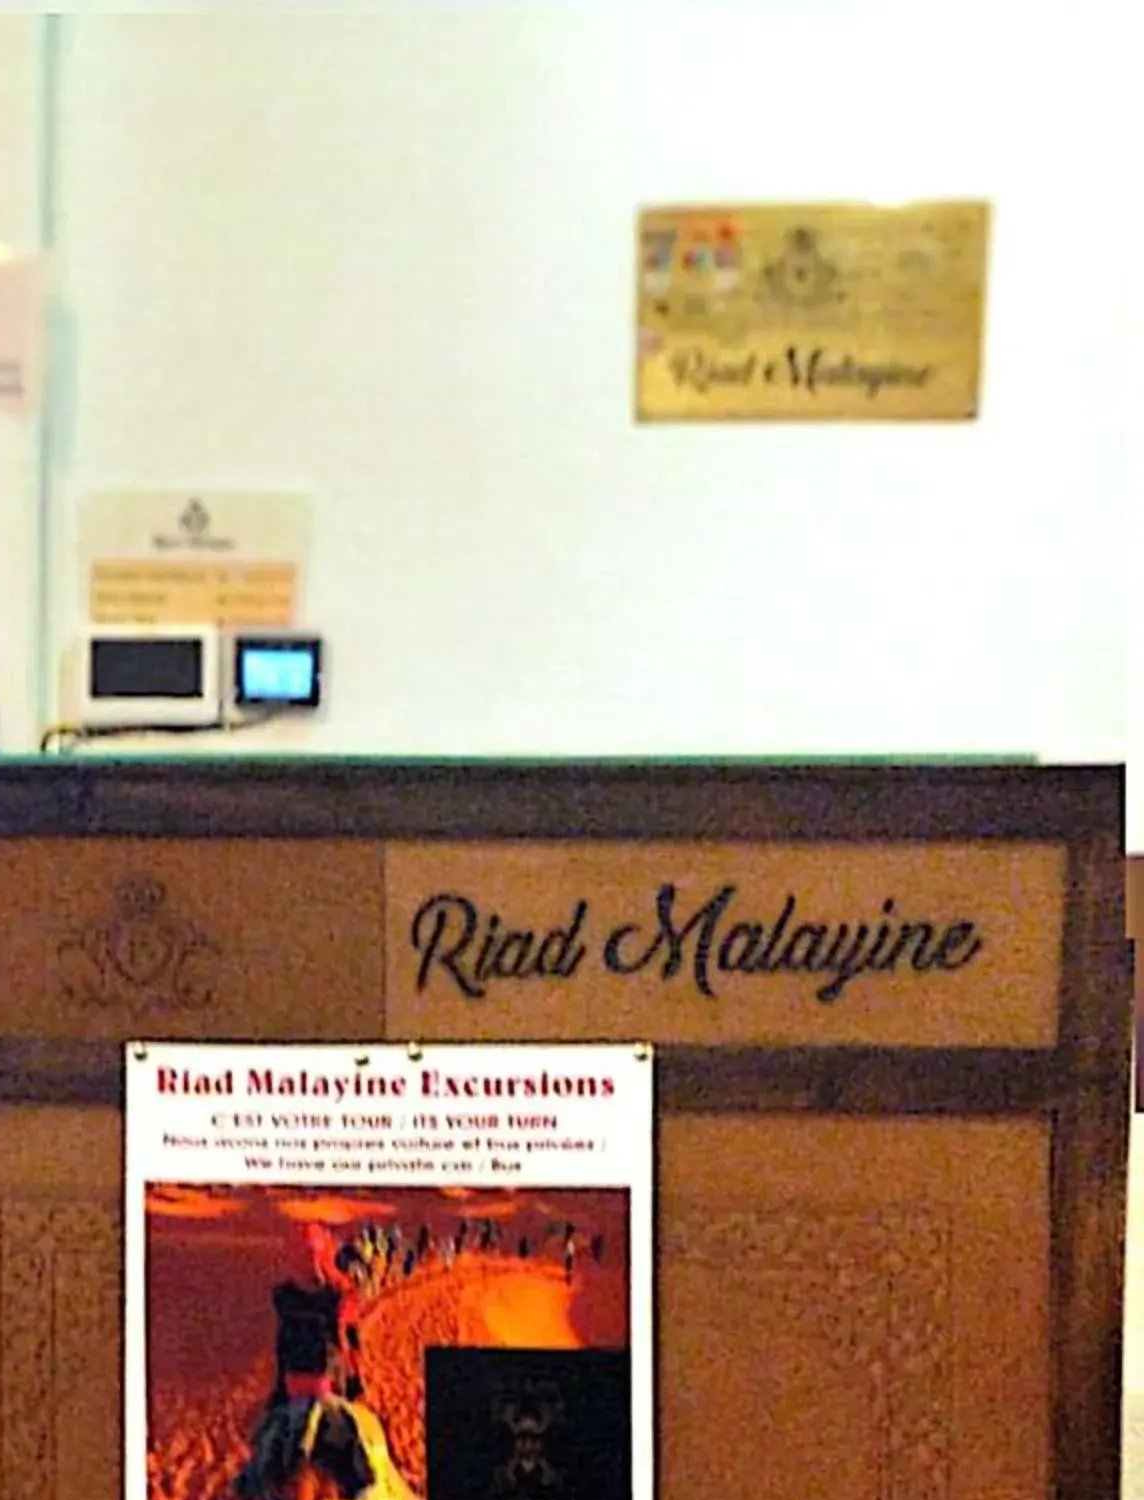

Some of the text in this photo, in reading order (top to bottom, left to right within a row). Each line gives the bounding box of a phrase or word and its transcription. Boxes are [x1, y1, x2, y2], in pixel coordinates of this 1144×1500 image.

[412, 882, 982, 1004] Riad Malayine
[156, 1067, 615, 1104] Riad Malayine Excursions
